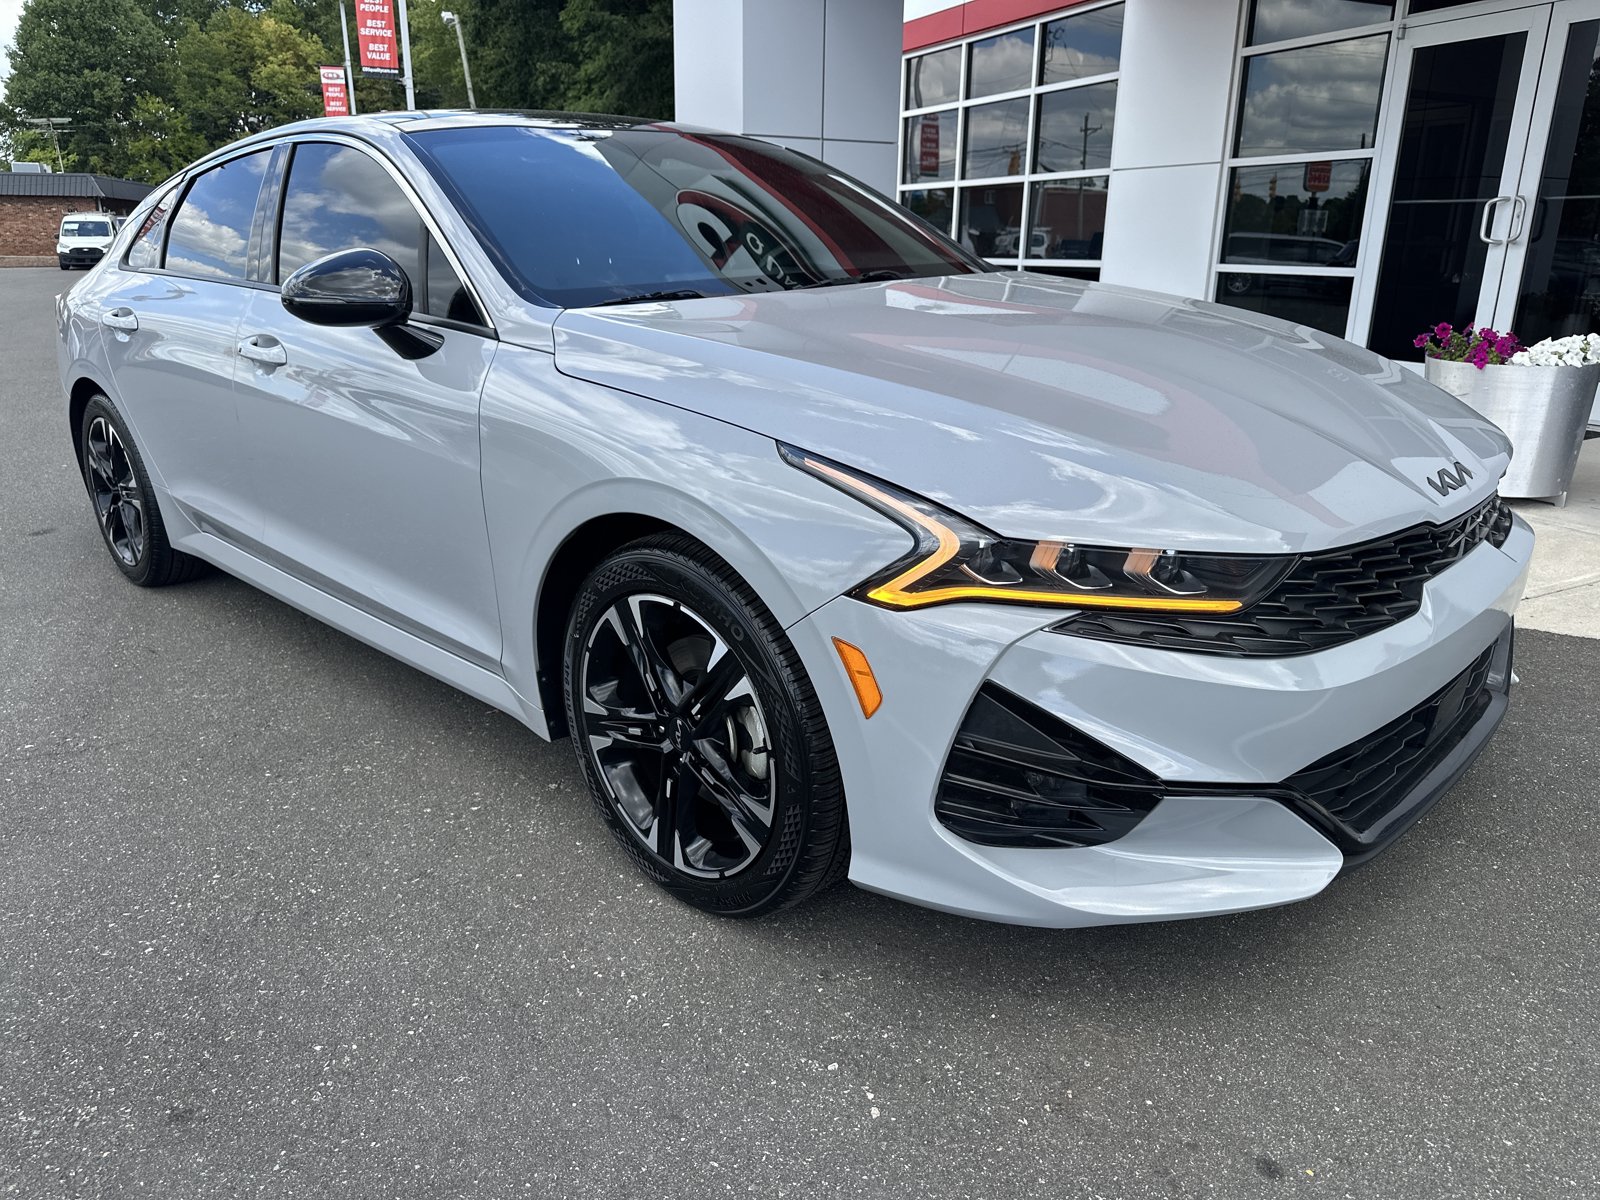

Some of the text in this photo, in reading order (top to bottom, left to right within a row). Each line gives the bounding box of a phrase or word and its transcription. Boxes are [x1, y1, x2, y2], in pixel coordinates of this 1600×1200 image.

[360, 4, 389, 13] PEOPLE
[367, 20, 386, 28] BEST
[360, 28, 392, 37] SERVICE
[367, 52, 390, 60] VALUE
[1426, 461, 1474, 497] KIA
